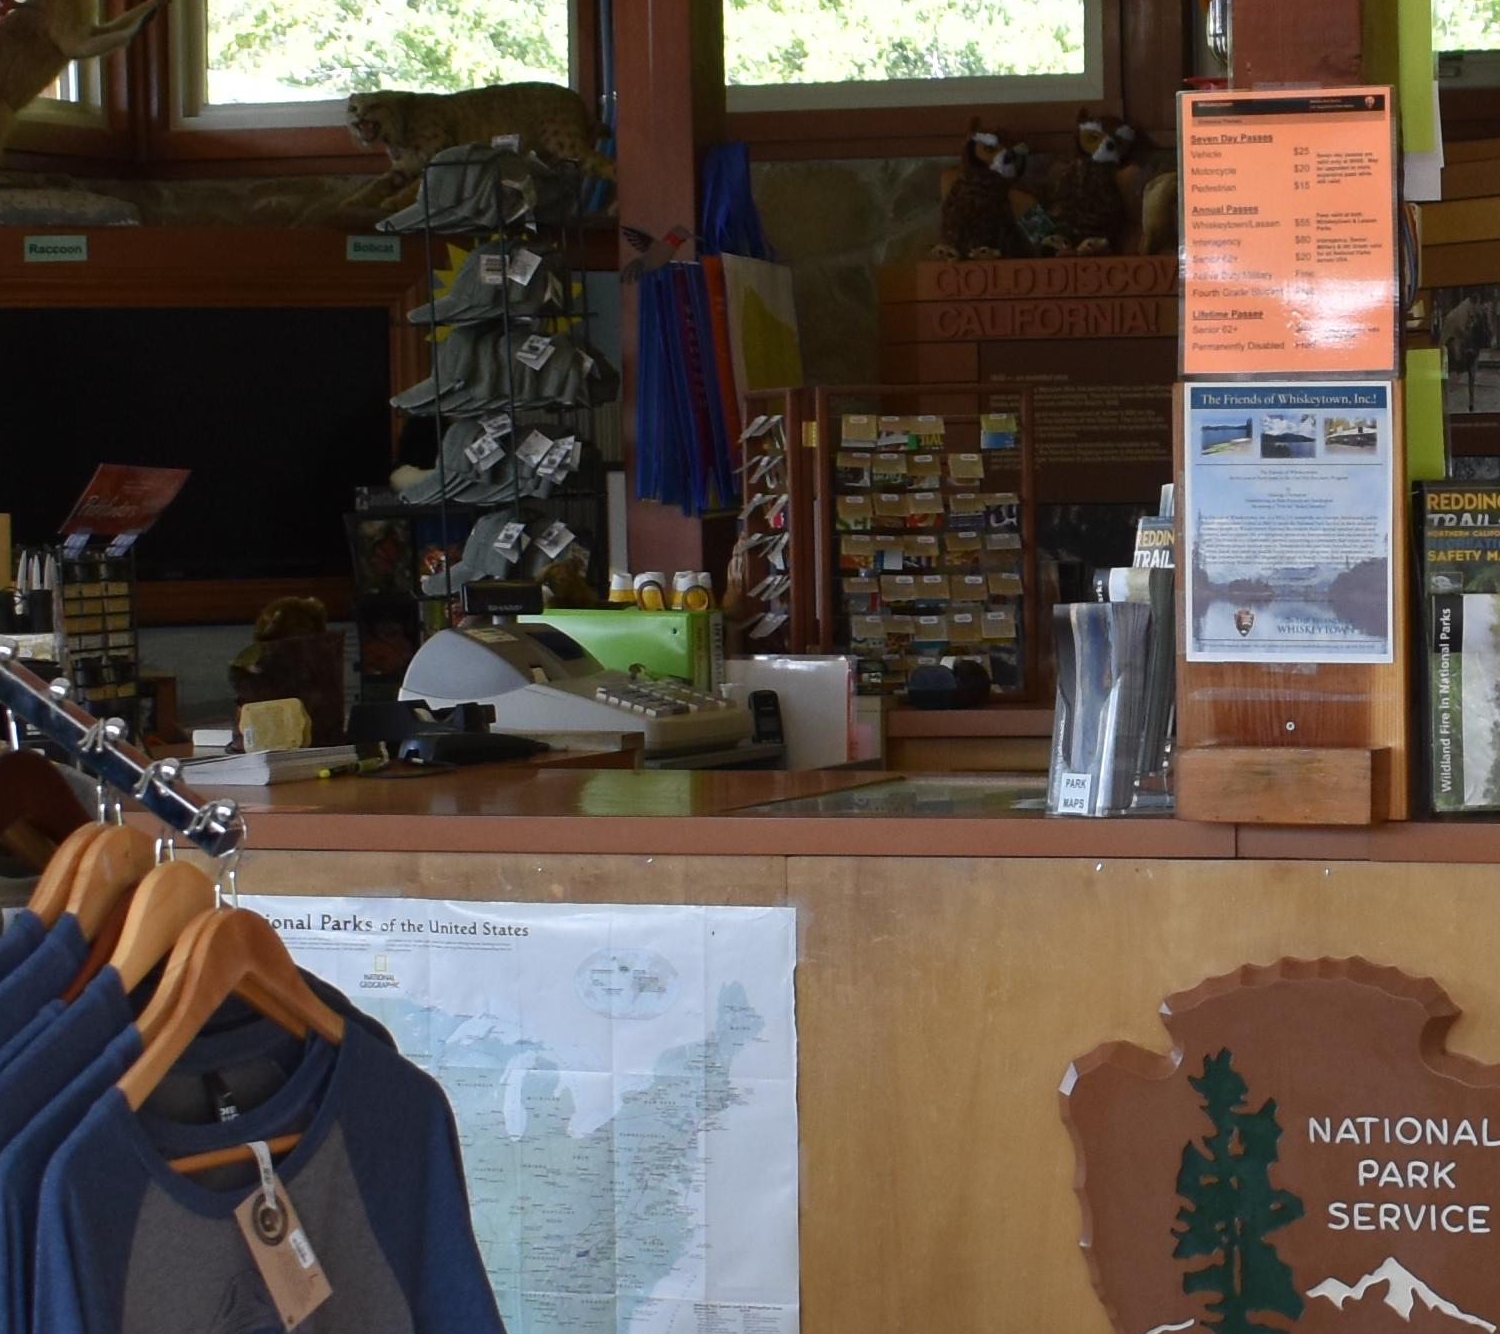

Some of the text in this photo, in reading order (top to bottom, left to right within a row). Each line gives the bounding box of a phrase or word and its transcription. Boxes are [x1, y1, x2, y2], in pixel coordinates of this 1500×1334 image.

[1191, 133, 1273, 144] Seven Day Passes
[1191, 146, 1310, 159] Vehicle $25
[1191, 163, 1310, 177] Motorcycle $20
[1191, 181, 1310, 193] Pedestrian $15
[1192, 205, 1259, 215] Annual Passes
[29, 244, 82, 254] Raccoon
[936, 259, 1179, 297] GOLD DISCOV
[1192, 288, 1220, 297] Fourth
[938, 302, 1161, 338] CALIFORNIA!
[1193, 309, 1264, 319] Lifetime Passes
[1193, 325, 1219, 334] Senior
[1192, 341, 1285, 351] Permanently Disabled
[1201, 393, 1221, 405] The
[1224, 393, 1262, 405] Friends
[1264, 393, 1276, 404] of
[1277, 392, 1352, 407] Whiskeytown,
[1137, 530, 1175, 547] REDDIN
[1427, 530, 1471, 538] NORTHERN
[1136, 549, 1175, 568] TRAIL
[1427, 550, 1480, 562] SAFETY
[1441, 608, 1451, 793] Wildland Fire in National Parks
[1065, 779, 1087, 789] PARK
[1063, 799, 1085, 809] MAPS
[264, 914, 530, 937] ional Parks of the United States
[1358, 1159, 1456, 1189] PARK
[1327, 1202, 1491, 1233] SERVICE
